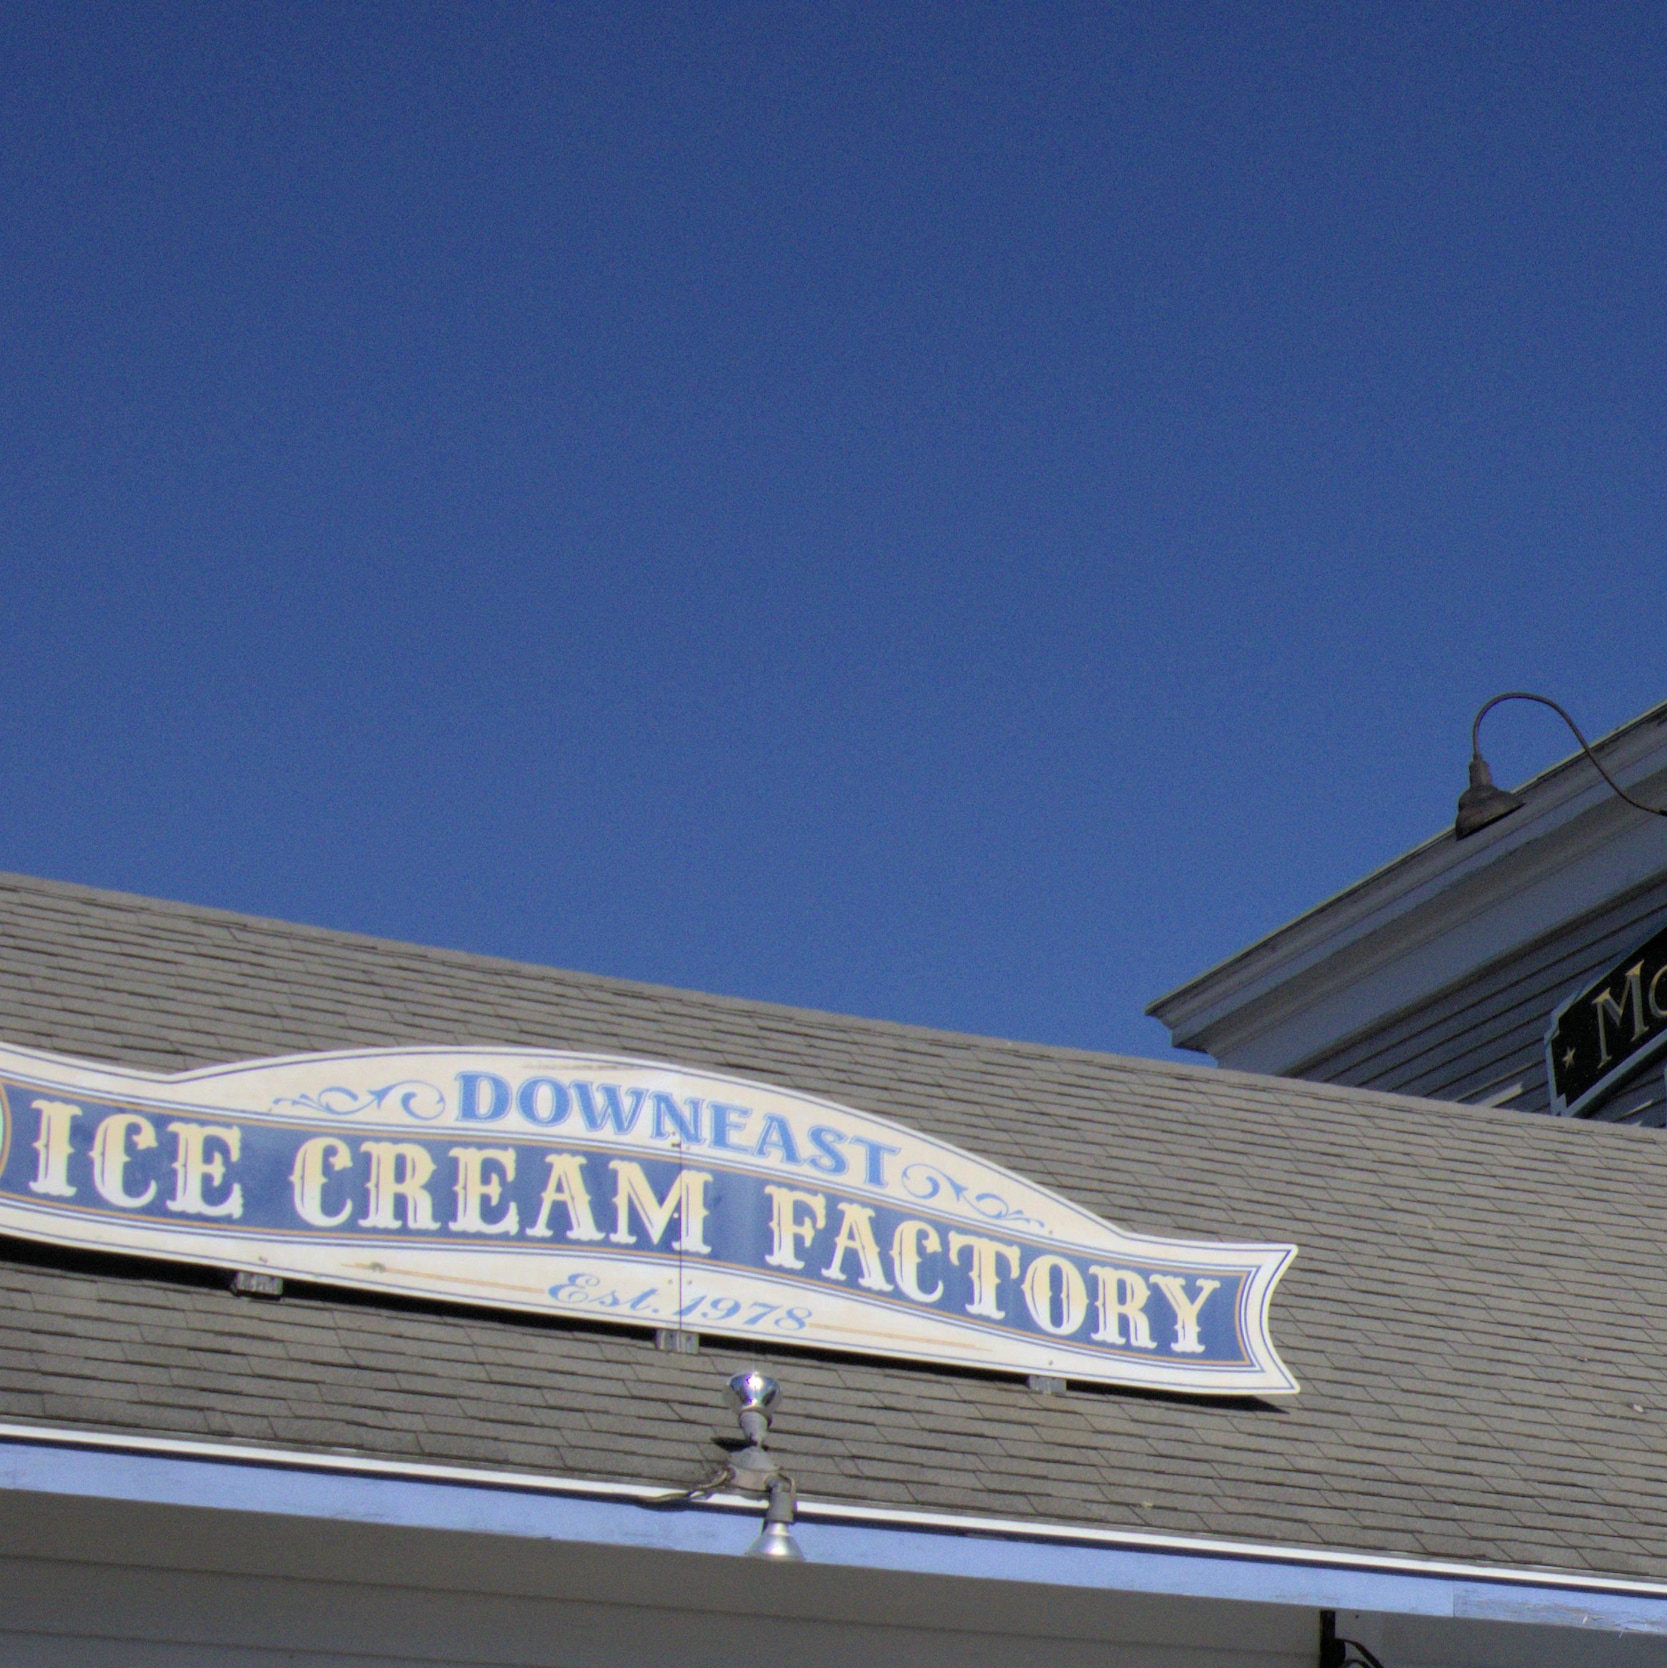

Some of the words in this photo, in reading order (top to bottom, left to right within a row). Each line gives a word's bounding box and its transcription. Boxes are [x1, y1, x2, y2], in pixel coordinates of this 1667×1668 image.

[453, 1070, 901, 1190] DOWNEAST
[30, 1100, 244, 1219] ICE
[292, 1137, 714, 1255] CREAM
[764, 1185, 1220, 1353] FACTORY
[549, 1272, 660, 1318] Est.
[678, 1290, 814, 1332] 1978
